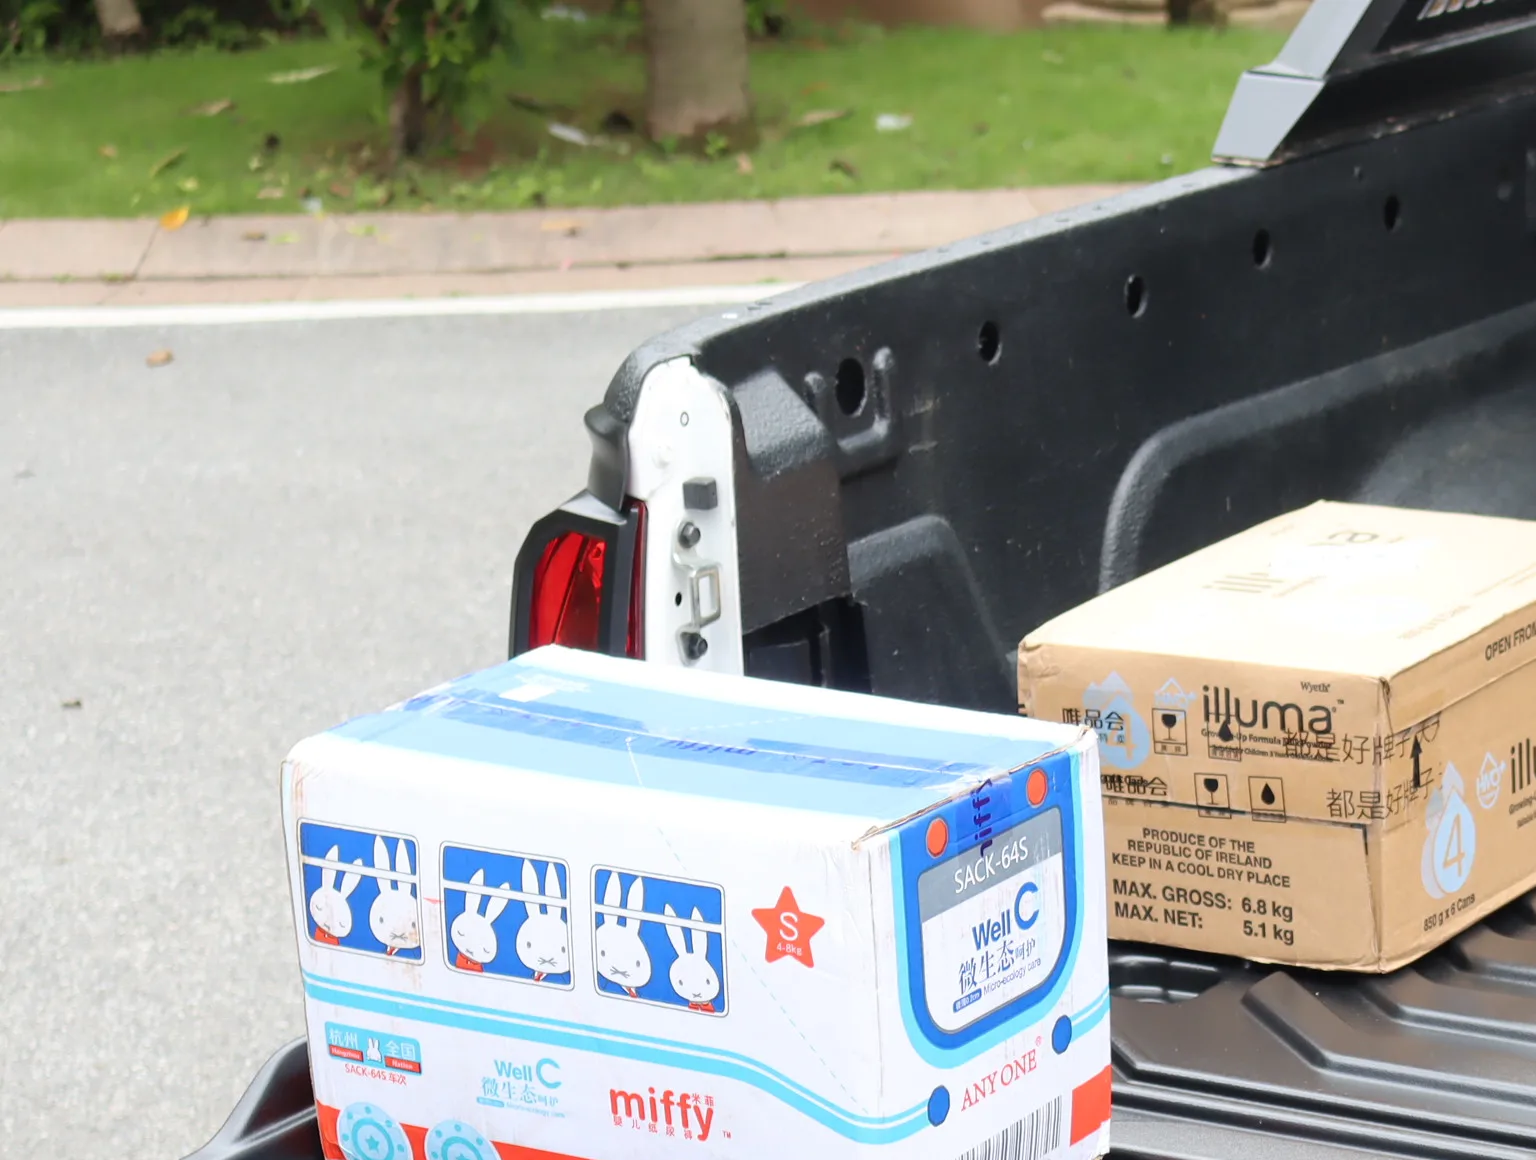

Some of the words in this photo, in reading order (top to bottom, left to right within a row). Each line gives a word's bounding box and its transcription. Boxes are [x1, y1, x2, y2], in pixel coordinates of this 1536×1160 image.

[1485, 634, 1511, 661] OPEN
[1301, 681, 1329, 694] Wyeth
[1202, 684, 1333, 735] illuma
[1249, 733, 1282, 746] Formula
[1127, 839, 1192, 859] REPUBLIC
[1195, 848, 1213, 861] OF
[1216, 852, 1272, 869] IRELAND
[1142, 827, 1205, 847] PRODUCE
[1208, 836, 1226, 849] OF
[1231, 839, 1255, 854] THE
[1442, 812, 1466, 878] 4
[954, 836, 1030, 895] SACK-64S
[1112, 852, 1146, 868] KEEP
[1149, 858, 1162, 870] IN
[1165, 861, 1175, 873] A
[1177, 862, 1214, 878] COOL
[1217, 867, 1243, 882] DRY
[1247, 871, 1291, 888] PLACE
[1112, 878, 1157, 900] MAX.
[1162, 885, 1232, 910] GROSS:
[1241, 897, 1267, 915] 6.8
[1272, 901, 1293, 922] kg
[1424, 913, 1437, 931] 850
[1450, 902, 1456, 916] 6
[1457, 893, 1476, 911] Cans
[779, 911, 799, 942] S
[1114, 901, 1159, 922] MAX.
[1164, 908, 1203, 929] NET:
[1243, 920, 1267, 938] 5.1
[1273, 924, 1294, 945] kg
[776, 942, 804, 957] 4-8kg
[385, 1040, 416, 1061] 全国
[344, 1063, 387, 1081] SACK-64S
[609, 1086, 715, 1142] miffy
